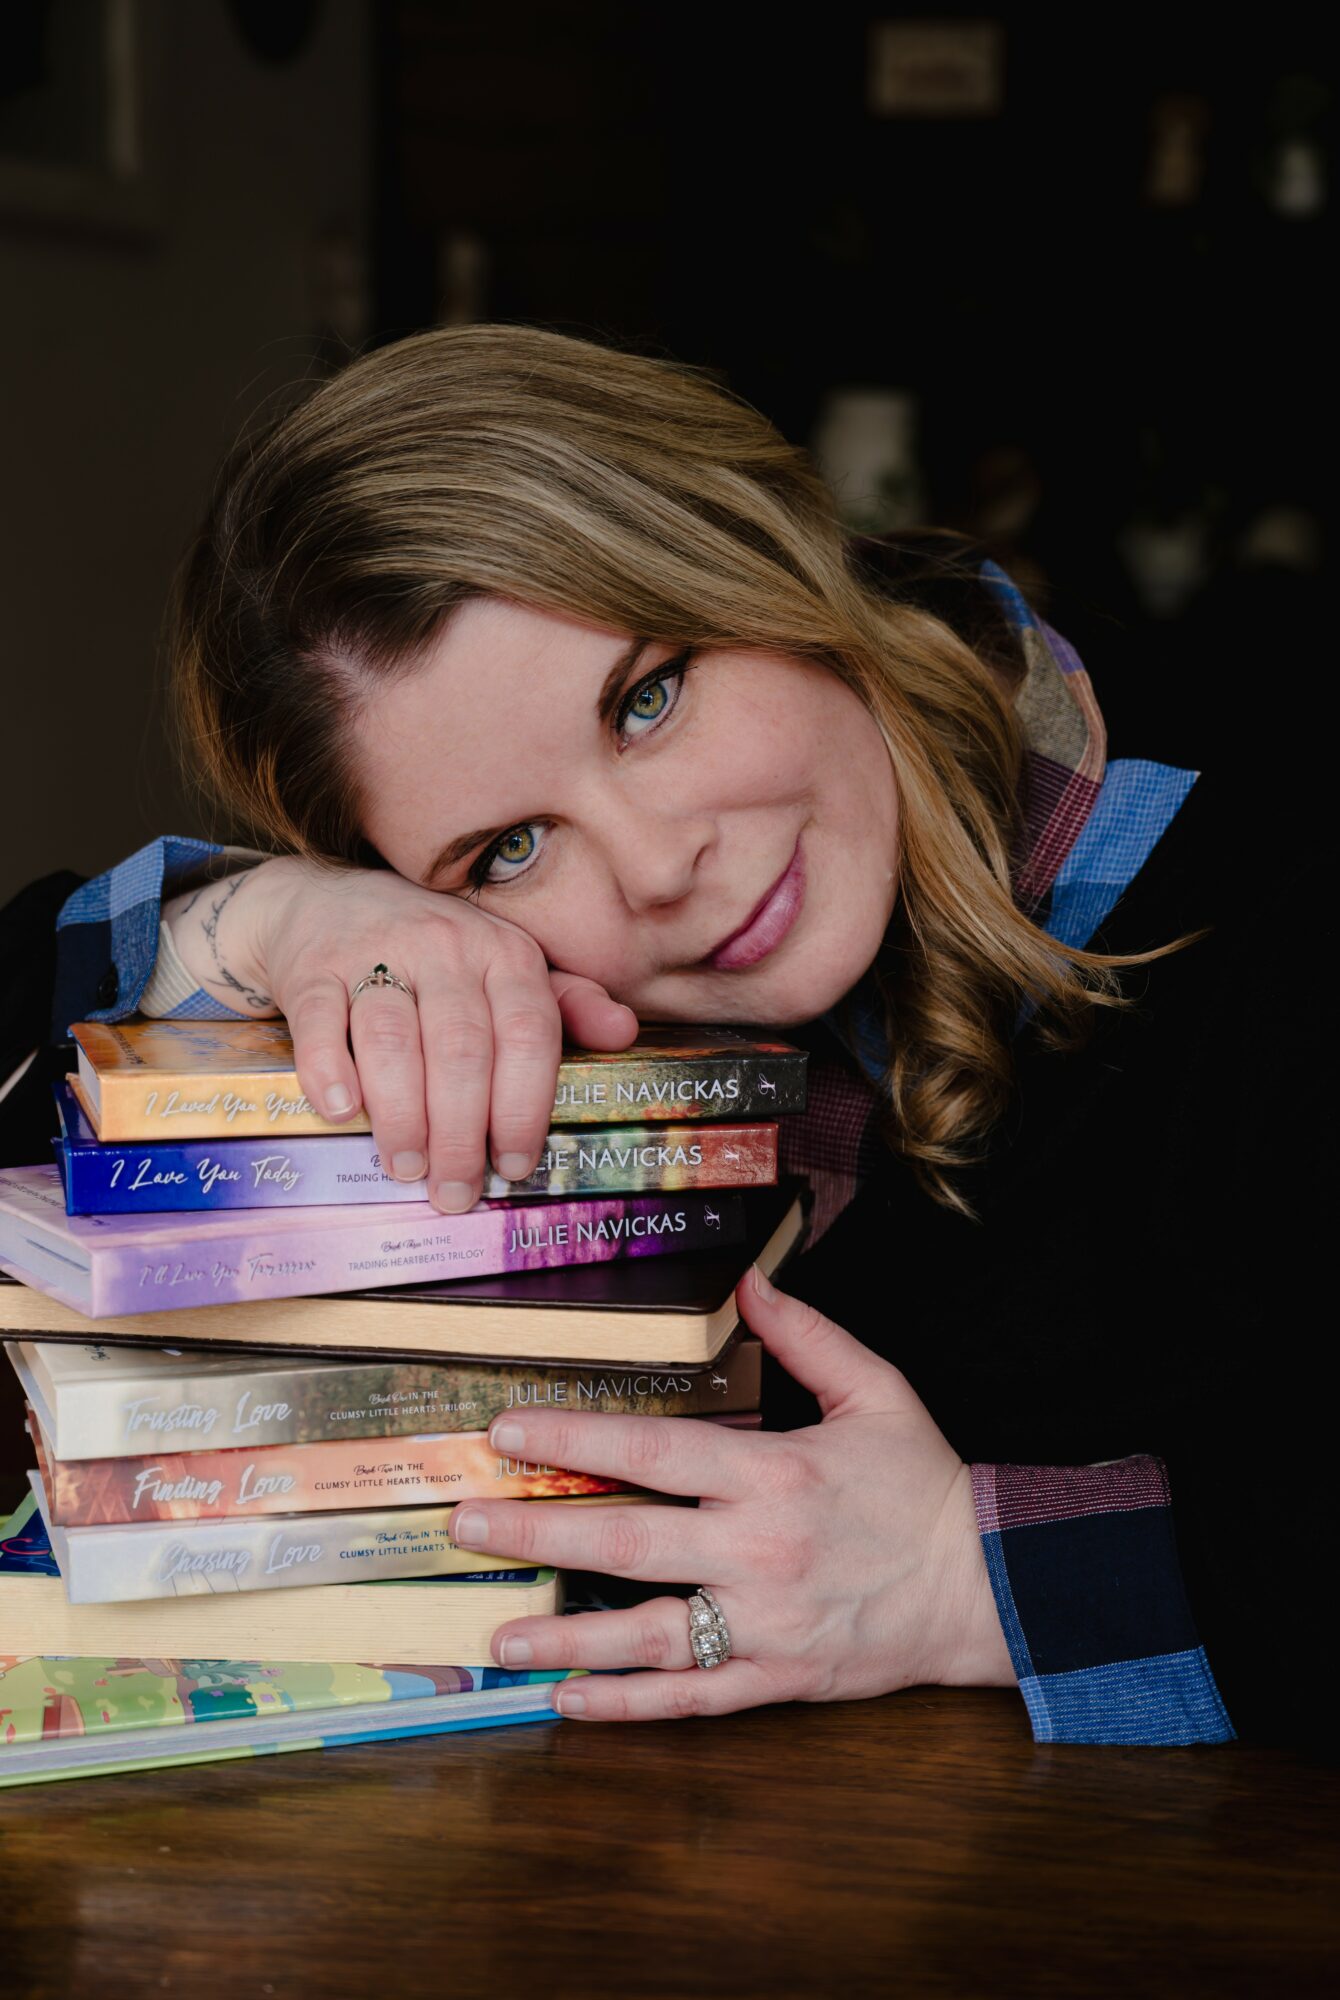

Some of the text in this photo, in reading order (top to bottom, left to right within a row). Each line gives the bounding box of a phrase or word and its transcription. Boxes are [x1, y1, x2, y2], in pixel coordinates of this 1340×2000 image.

[555, 1079, 739, 1105] ULIE NAVICKAS
[144, 1091, 317, 1122] I Loved You Yeste
[579, 1145, 703, 1170] NAVICKAS
[110, 1155, 304, 1193] I Love You Today
[336, 1173, 379, 1183] TRADING
[381, 1241, 401, 1252] Book
[423, 1237, 433, 1246] IN
[435, 1235, 452, 1245] THE
[509, 1212, 687, 1253] JULIE NAVICKAS
[348, 1248, 485, 1271] TRADING HEARTBEATS TRILOGY
[368, 1393, 391, 1405] Book
[408, 1391, 419, 1400] IN
[422, 1390, 440, 1399] THE
[507, 1376, 692, 1408] JULIE NAVICKAS
[121, 1391, 293, 1440] Trusting Love
[330, 1401, 477, 1421] CLUMSY LITTLE HEARTS TRILOGY
[353, 1464, 376, 1476] Book
[377, 1463, 394, 1474] Two
[407, 1463, 424, 1471] THE
[132, 1464, 296, 1509] Finding Love
[314, 1474, 463, 1490] CLUMSY LITTLE HEARTS TRILOGY
[375, 1532, 397, 1544] Book
[420, 1531, 430, 1539] IN
[157, 1533, 322, 1583] Chasing Love
[339, 1549, 375, 1559] CLUMSY
[378, 1547, 408, 1556] LITTLE
[411, 1544, 445, 1553] HEARTS
